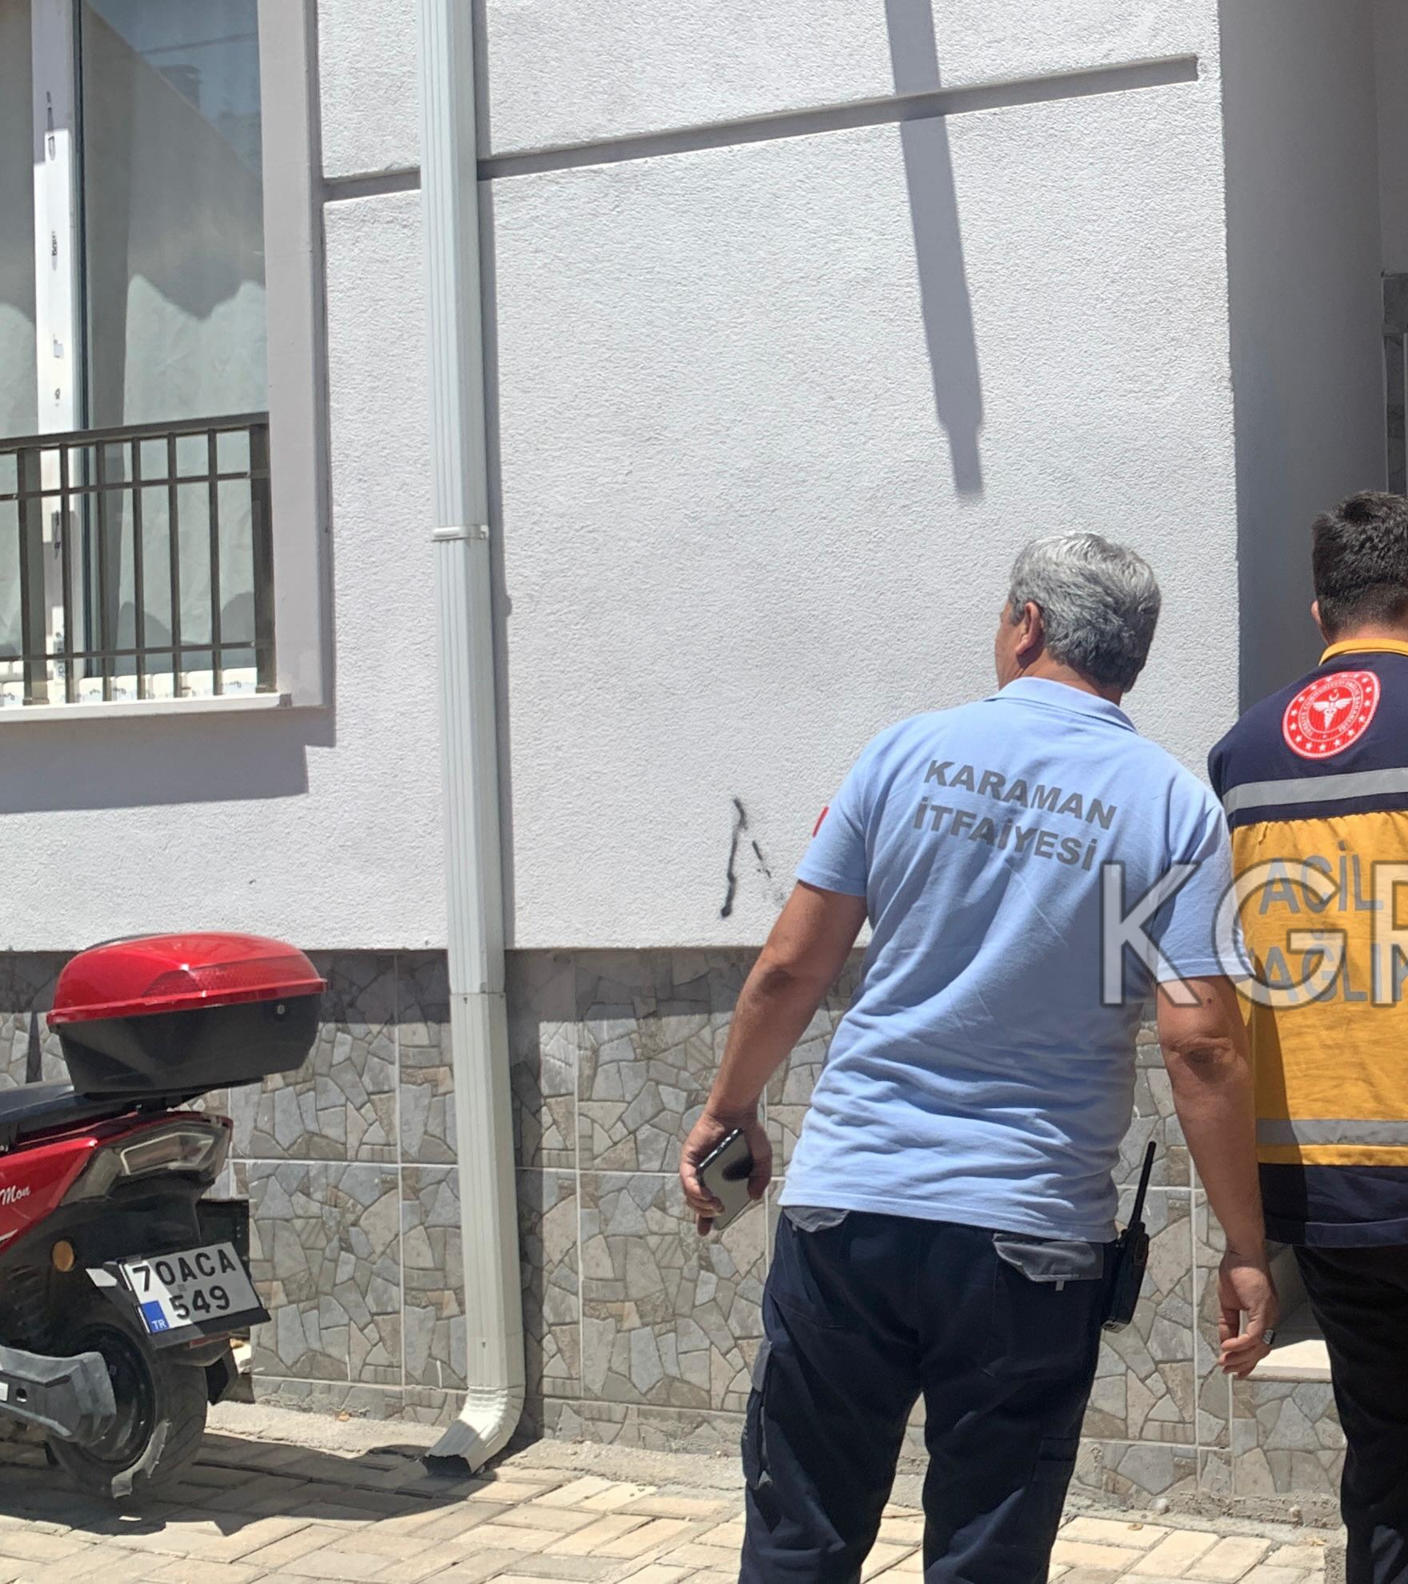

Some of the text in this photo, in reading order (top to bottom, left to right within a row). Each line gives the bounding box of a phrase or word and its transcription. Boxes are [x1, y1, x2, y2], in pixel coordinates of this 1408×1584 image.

[923, 759, 1118, 830] KARAMAN
[912, 795, 1099, 872] İTFAİYESİ
[1259, 839, 1384, 916] ACİL
[151, 1319, 167, 1330] TR
[169, 1285, 230, 1320] 549
